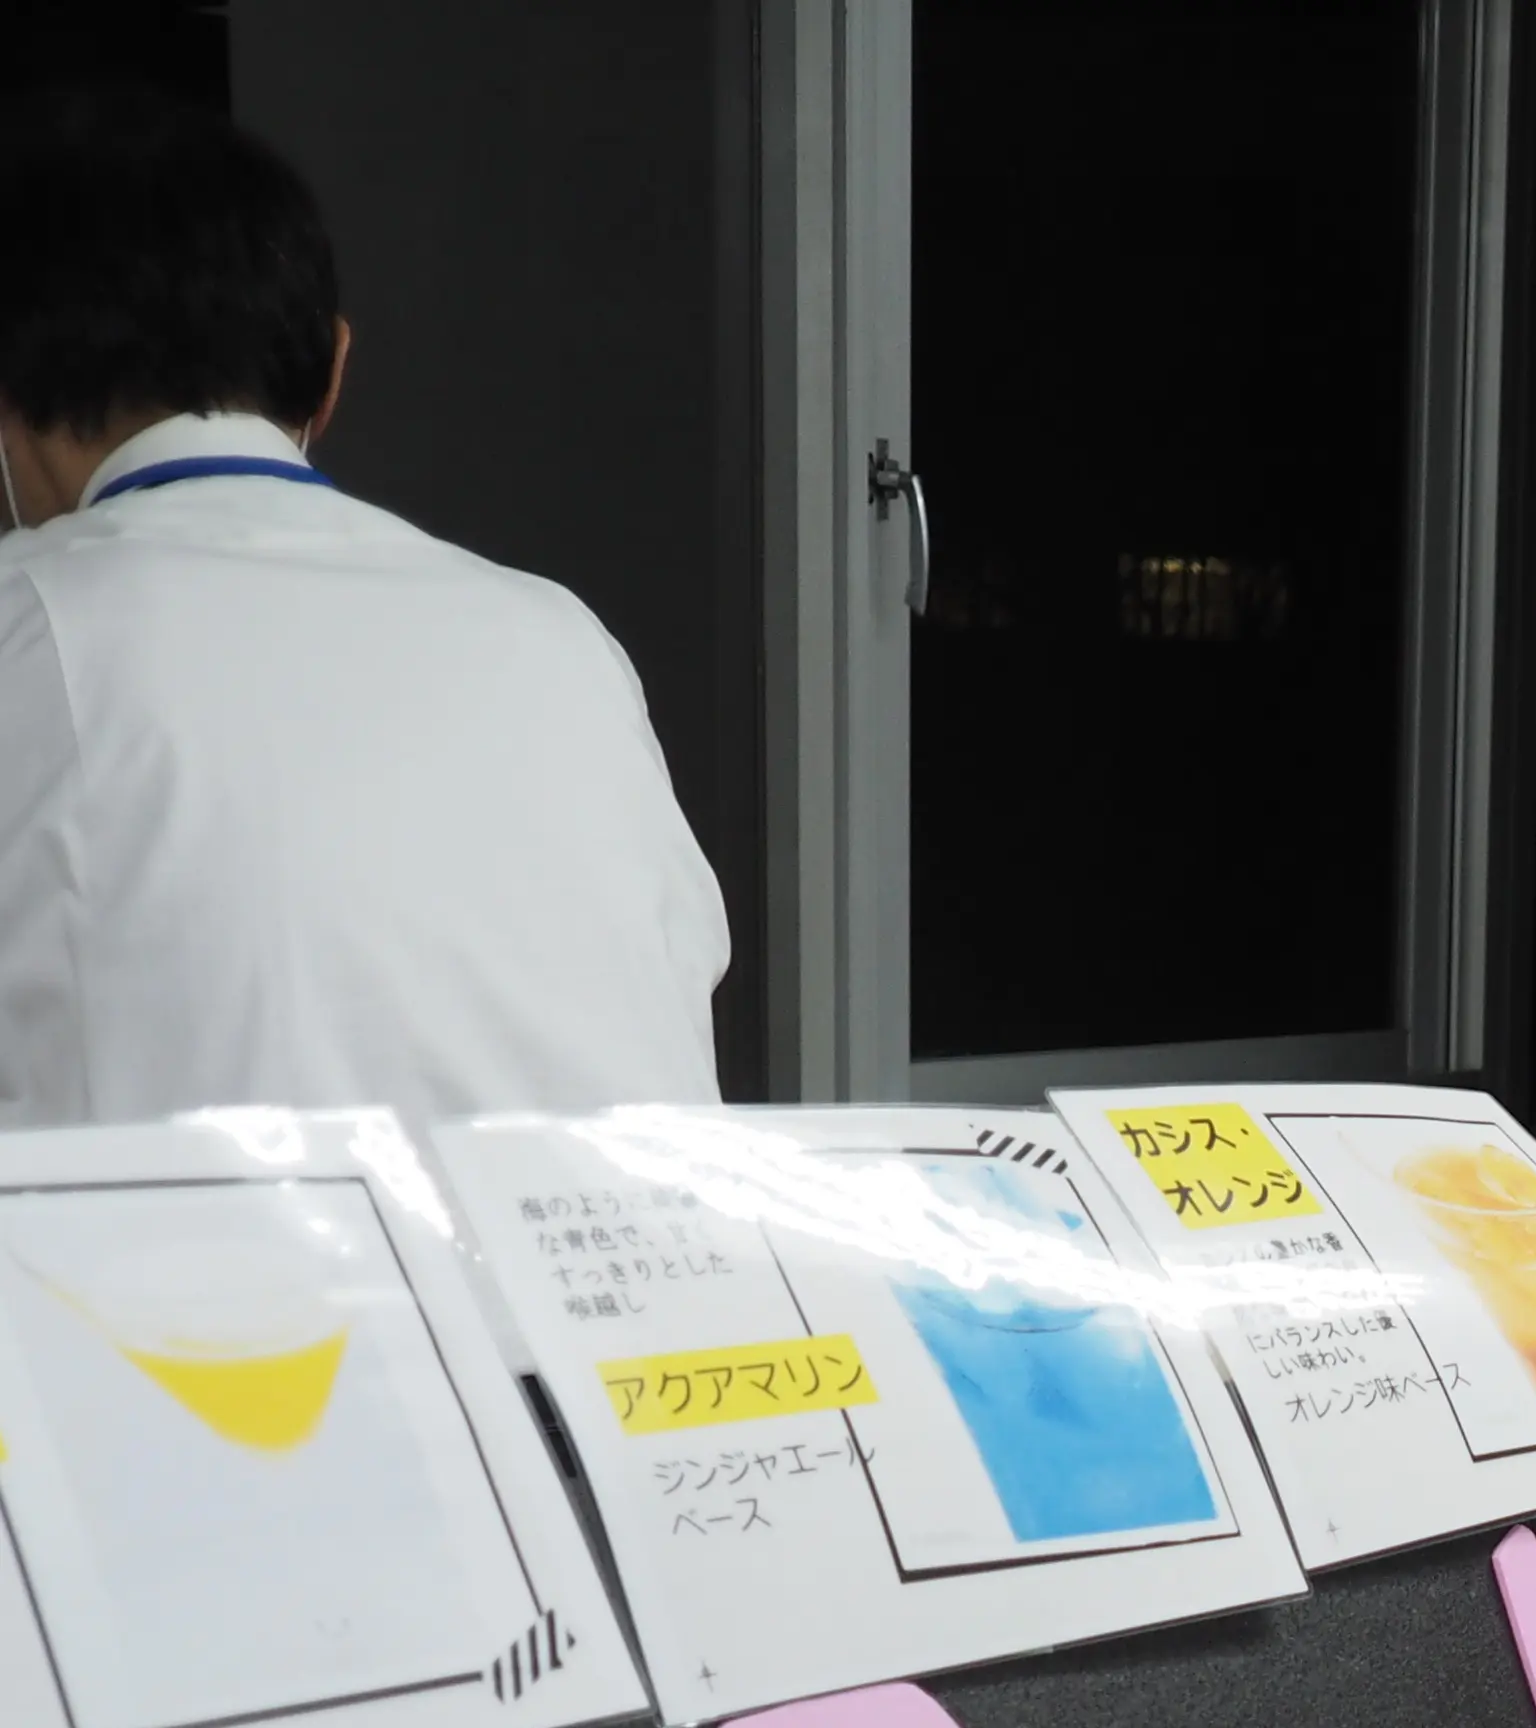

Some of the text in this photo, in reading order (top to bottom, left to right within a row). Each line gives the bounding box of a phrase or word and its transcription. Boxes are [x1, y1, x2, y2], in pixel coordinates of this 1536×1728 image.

[1162, 1168, 1304, 1216] オレンジ
[605, 1354, 862, 1420] アクアマリン
[1285, 1362, 1472, 1423] オレンジ味ベース
[653, 1436, 876, 1494] ジンジャエール
[672, 1498, 772, 1535] ベース
